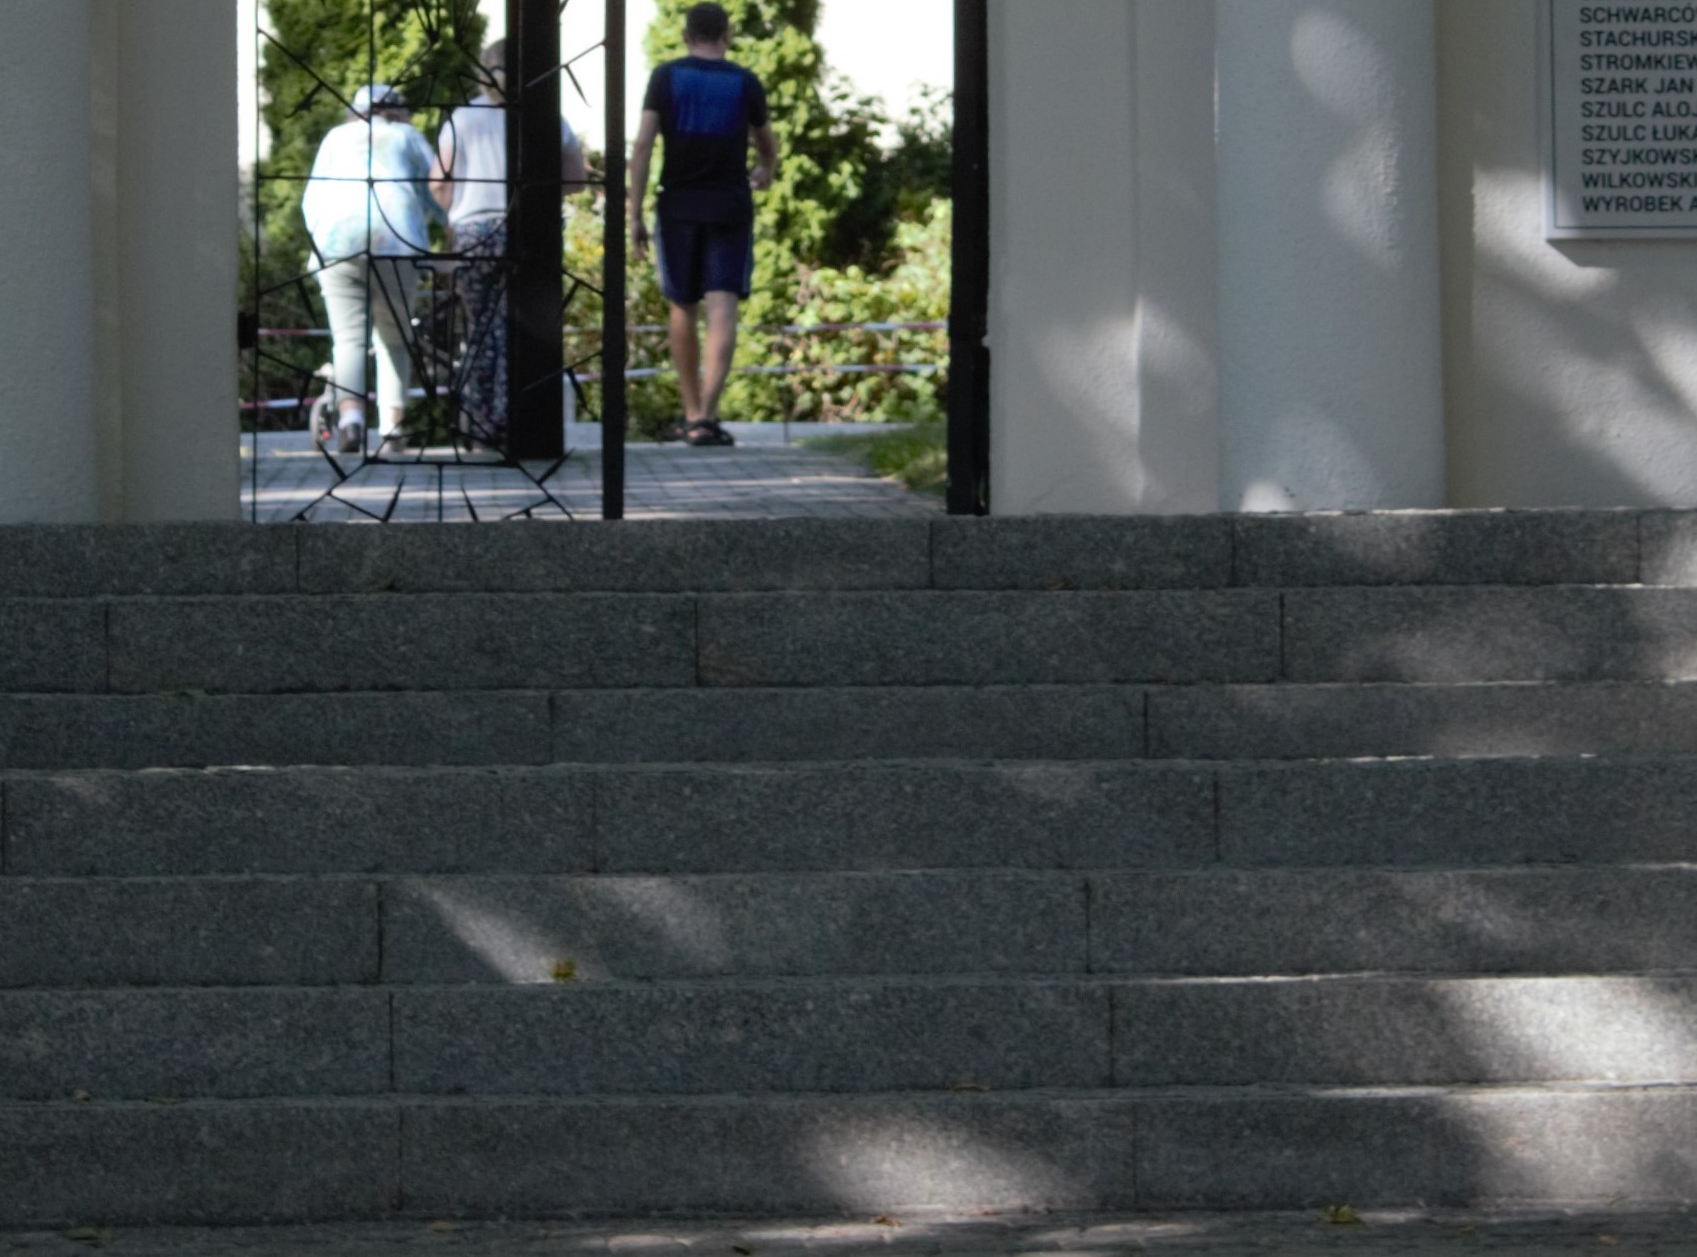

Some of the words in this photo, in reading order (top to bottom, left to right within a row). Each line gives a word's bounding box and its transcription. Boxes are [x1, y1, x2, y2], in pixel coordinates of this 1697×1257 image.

[1581, 78, 1648, 94] SZARK
[1654, 78, 1694, 94] JAN
[1581, 101, 1646, 118] SZULC
[1581, 125, 1646, 141] SZULC
[1582, 172, 1697, 188] WILKOWSKI
[1583, 196, 1683, 212] WYROBEK
